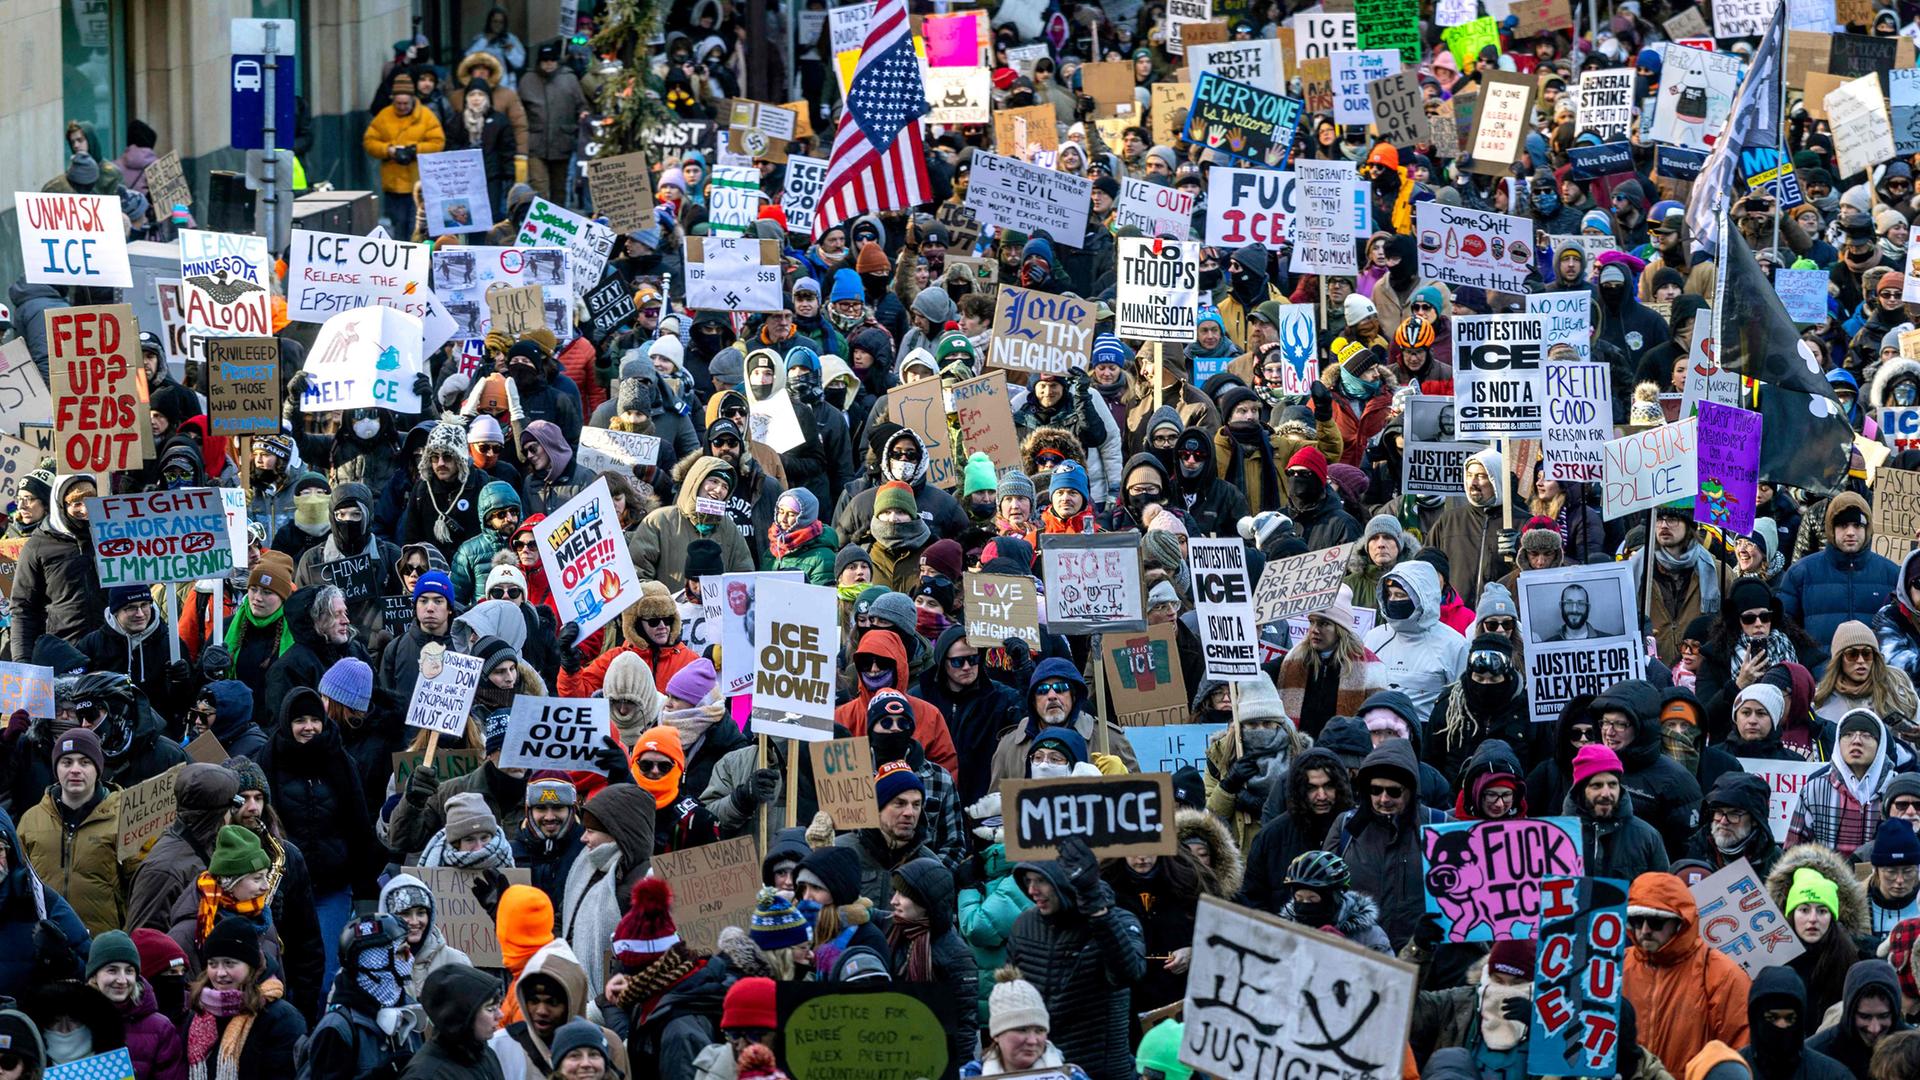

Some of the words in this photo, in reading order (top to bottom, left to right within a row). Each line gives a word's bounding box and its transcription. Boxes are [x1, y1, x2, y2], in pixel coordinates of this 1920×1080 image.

[1310, 20, 1354, 38] ICE
[1209, 48, 1261, 64] KRISTI
[1217, 63, 1260, 78] NOEM
[1582, 75, 1630, 90] GENERAL
[1374, 76, 1405, 99] ICE
[1581, 90, 1630, 107] STRIKE:
[1198, 75, 1300, 127] EVERYONE
[1344, 99, 1369, 111] OUR
[1376, 92, 1416, 118] OUT
[1217, 110, 1272, 135] welcome
[1389, 114, 1410, 128] OF
[1596, 109, 1618, 122] PATH
[1619, 108, 1629, 121] TO
[1389, 125, 1418, 142] MN
[1577, 158, 1598, 167] Alex
[1600, 152, 1628, 164] Pretti
[1662, 157, 1688, 169] Renee
[1299, 166, 1352, 180] IMMIGRANTS
[712, 191, 759, 209] OUT
[1017, 181, 1058, 202] EVIL
[1055, 181, 1084, 196] TERROR
[1125, 181, 1148, 202] ICE
[1157, 189, 1192, 216] OUT!
[1304, 186, 1341, 197] WELCOME
[26, 197, 104, 232] UNMASK
[969, 198, 983, 207] WE
[988, 203, 1012, 214] MUST
[1017, 210, 1069, 229] EXORCISE
[971, 186, 987, 196] WE
[991, 191, 1015, 203] OWN
[1020, 198, 1040, 210] THIS
[1048, 205, 1069, 218] EVIL
[994, 214, 1012, 224] THIS
[1118, 204, 1156, 235] EPSTEIN
[1223, 210, 1286, 244] ICE
[1305, 216, 1334, 227] MASKED
[1441, 207, 1478, 229] Same
[1478, 215, 1512, 235] Shit
[181, 232, 264, 263] LEAVE
[721, 239, 735, 249] ICE
[1326, 233, 1350, 242] THUGS
[41, 239, 100, 275] ICE
[308, 235, 350, 266] ICE
[359, 242, 417, 270] OUT
[1139, 244, 1179, 260] NO
[1301, 247, 1317, 262] NOT
[1319, 249, 1328, 260] SO
[1330, 245, 1356, 265] MUCH!
[183, 255, 259, 284] MINNESOTA
[304, 267, 360, 284] RELEASE
[370, 275, 398, 287] THE
[690, 270, 704, 279] IDF
[1123, 257, 1195, 290] TROOPS
[1422, 263, 1486, 287] Different
[1489, 273, 1531, 294] Hats
[300, 287, 368, 310] EPSTEIN
[496, 289, 536, 315] FUCK
[591, 283, 621, 309] STAY
[1149, 295, 1166, 305] IN
[1557, 299, 1586, 312] ONE
[505, 310, 529, 333] ICE
[595, 297, 633, 329] SALTY
[1003, 287, 1086, 339] Love
[1121, 303, 1194, 327] MINNESOTA
[51, 313, 120, 357] FED
[1040, 321, 1091, 350] THY
[1458, 321, 1541, 341] PROTESTING
[210, 343, 277, 361] PRIVILEGED
[993, 337, 1088, 376] NEIGHBOR
[1459, 345, 1539, 371] ICE
[68, 354, 127, 395] UP?
[221, 363, 276, 381] PROTEST
[1546, 365, 1606, 401] PRETTI
[232, 383, 265, 394] THOSE
[305, 380, 354, 405] MELT
[1472, 382, 1486, 403] IS
[1490, 382, 1518, 403] NOT
[1524, 382, 1533, 402] A
[57, 394, 137, 431] FEDS
[212, 400, 236, 411] WHO
[1460, 406, 1541, 418] CRIME!
[1550, 399, 1596, 425] GOOD
[1549, 429, 1586, 442] REASON
[1589, 429, 1605, 440] FOR
[1698, 426, 1747, 451] MEMORY
[66, 433, 138, 472] OUT
[1409, 450, 1463, 466] JUSTICE
[1547, 449, 1603, 462] NATIONAL
[1604, 436, 1643, 484] NO
[1642, 421, 1697, 469] SECRET
[1409, 465, 1443, 481] ALEX
[1605, 465, 1683, 516] POLICE
[103, 492, 213, 519] FIGHT
[95, 513, 224, 541] IGNORANCE
[548, 522, 575, 551] HEY
[572, 497, 600, 529] ICE!
[1882, 510, 1915, 536] FUCK
[137, 537, 179, 557] NOT
[555, 521, 603, 570] MELT
[1192, 546, 1242, 569] PROTESTING
[100, 550, 233, 583] IMMIGRANTS
[321, 556, 369, 581] CHINGA
[561, 539, 616, 589] OFF!!!
[1058, 551, 1122, 589] ICE
[1259, 560, 1346, 591] PRETENDING
[1264, 554, 1316, 577] STOP
[1063, 590, 1122, 609] OUT
[1195, 574, 1247, 603] ICE
[1256, 589, 1287, 605] YOUR
[1291, 575, 1341, 598] RACISM
[386, 610, 396, 618] MY
[978, 603, 1013, 620] THY
[1271, 592, 1338, 618] PATRIOTISM
[772, 622, 819, 651] ICE
[970, 623, 1037, 641] NEIGHBOR
[1218, 616, 1235, 641] NOT
[444, 654, 481, 670] DISHONEST
[760, 646, 827, 679] OUT
[1128, 653, 1156, 673] ICE
[1206, 645, 1255, 660] CRIME!
[1533, 650, 1596, 676] JUSTICE
[1599, 648, 1630, 672] FOR
[456, 671, 477, 688] DON
[756, 671, 830, 704] NOW!!
[1535, 676, 1574, 701] ALEX
[418, 692, 464, 710] SYCOPHANTS
[412, 707, 442, 726] MUST
[442, 714, 460, 732] GO!
[541, 705, 592, 730] ICE
[1157, 707, 1185, 726] ICE
[529, 725, 598, 746] OUT
[1169, 735, 1186, 754] IF
[519, 741, 601, 762] NOW
[823, 741, 858, 774] OPE!
[123, 794, 145, 814] ALL
[152, 774, 173, 795] ARE
[818, 780, 835, 802] NO
[839, 776, 873, 801] NAZIS
[1020, 794, 1100, 840] MELT
[124, 818, 161, 846] EXCEPT
[656, 850, 696, 878] WE
[702, 840, 752, 869] WANT
[1481, 825, 1571, 879] FUCK
[699, 901, 723, 914] AND
[1728, 875, 1793, 953] FUCK
[1536, 879, 1576, 1032] ICE
[1585, 914, 1622, 1067] OUT!
[809, 1006, 869, 1021] JUSTICE
